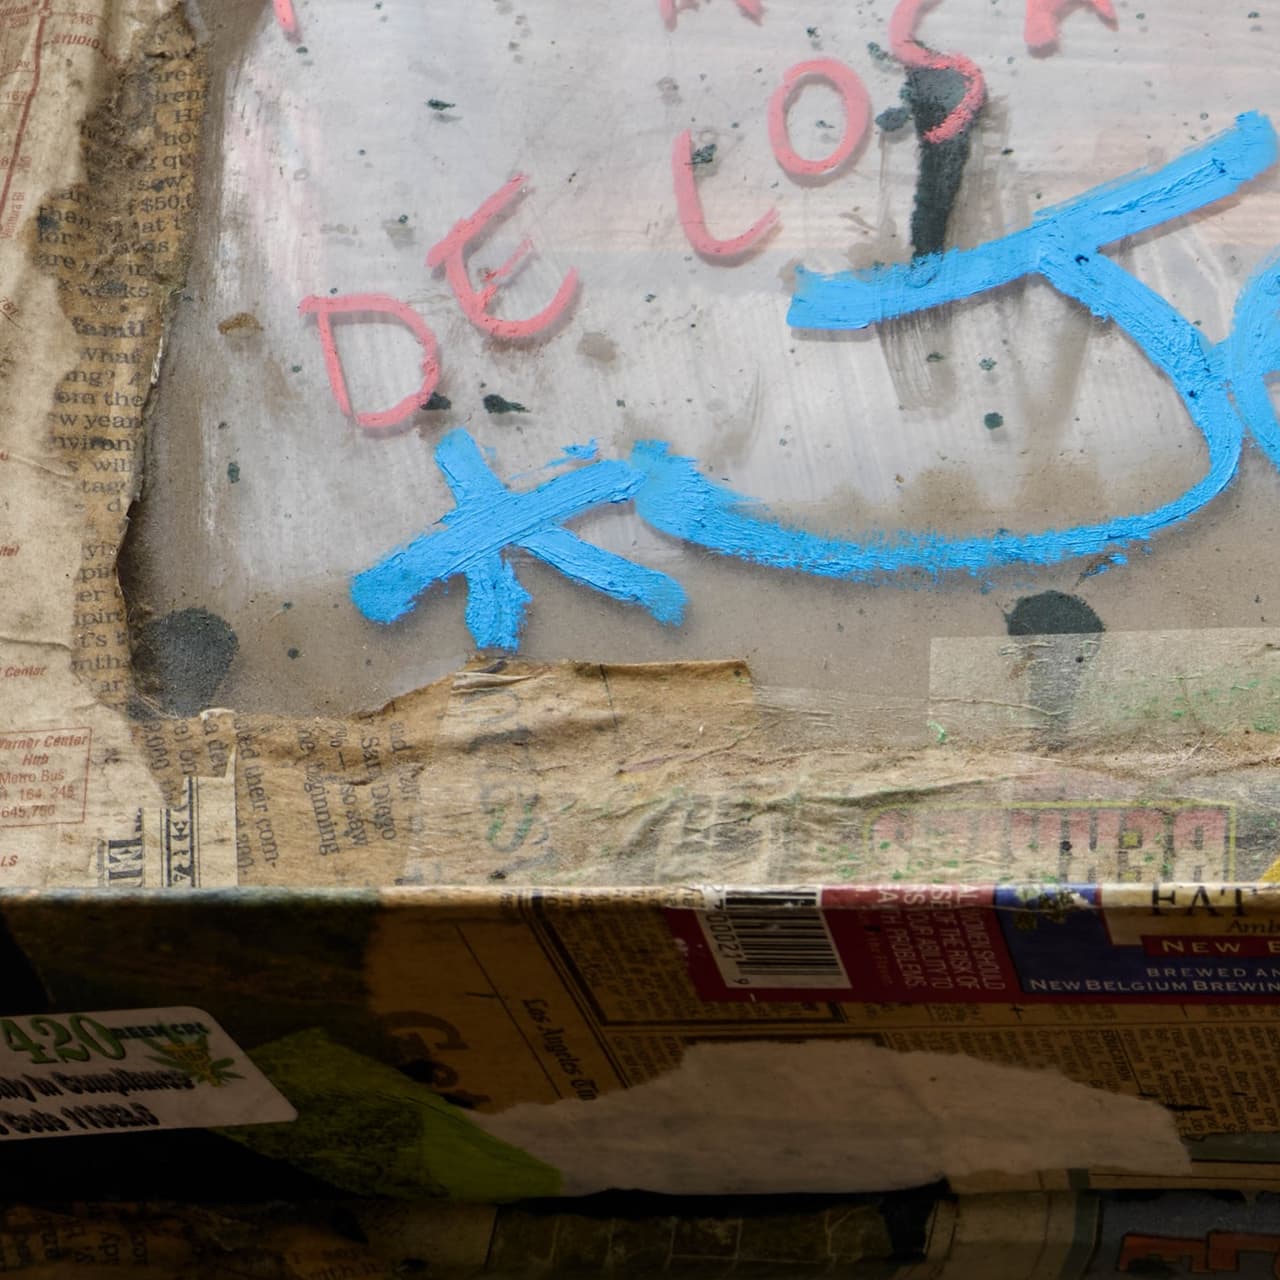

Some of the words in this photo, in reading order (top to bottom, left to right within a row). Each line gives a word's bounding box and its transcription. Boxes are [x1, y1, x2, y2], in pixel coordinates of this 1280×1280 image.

[300, 174, 580, 428] DE
[45, 733, 89, 748] Center
[1161, 939, 1243, 955] NEW
[1145, 966, 1248, 979] BREWED
[1029, 978, 1081, 992] NEW
[1085, 979, 1189, 993] BELGIUM
[0, 1015, 126, 1064] 420
